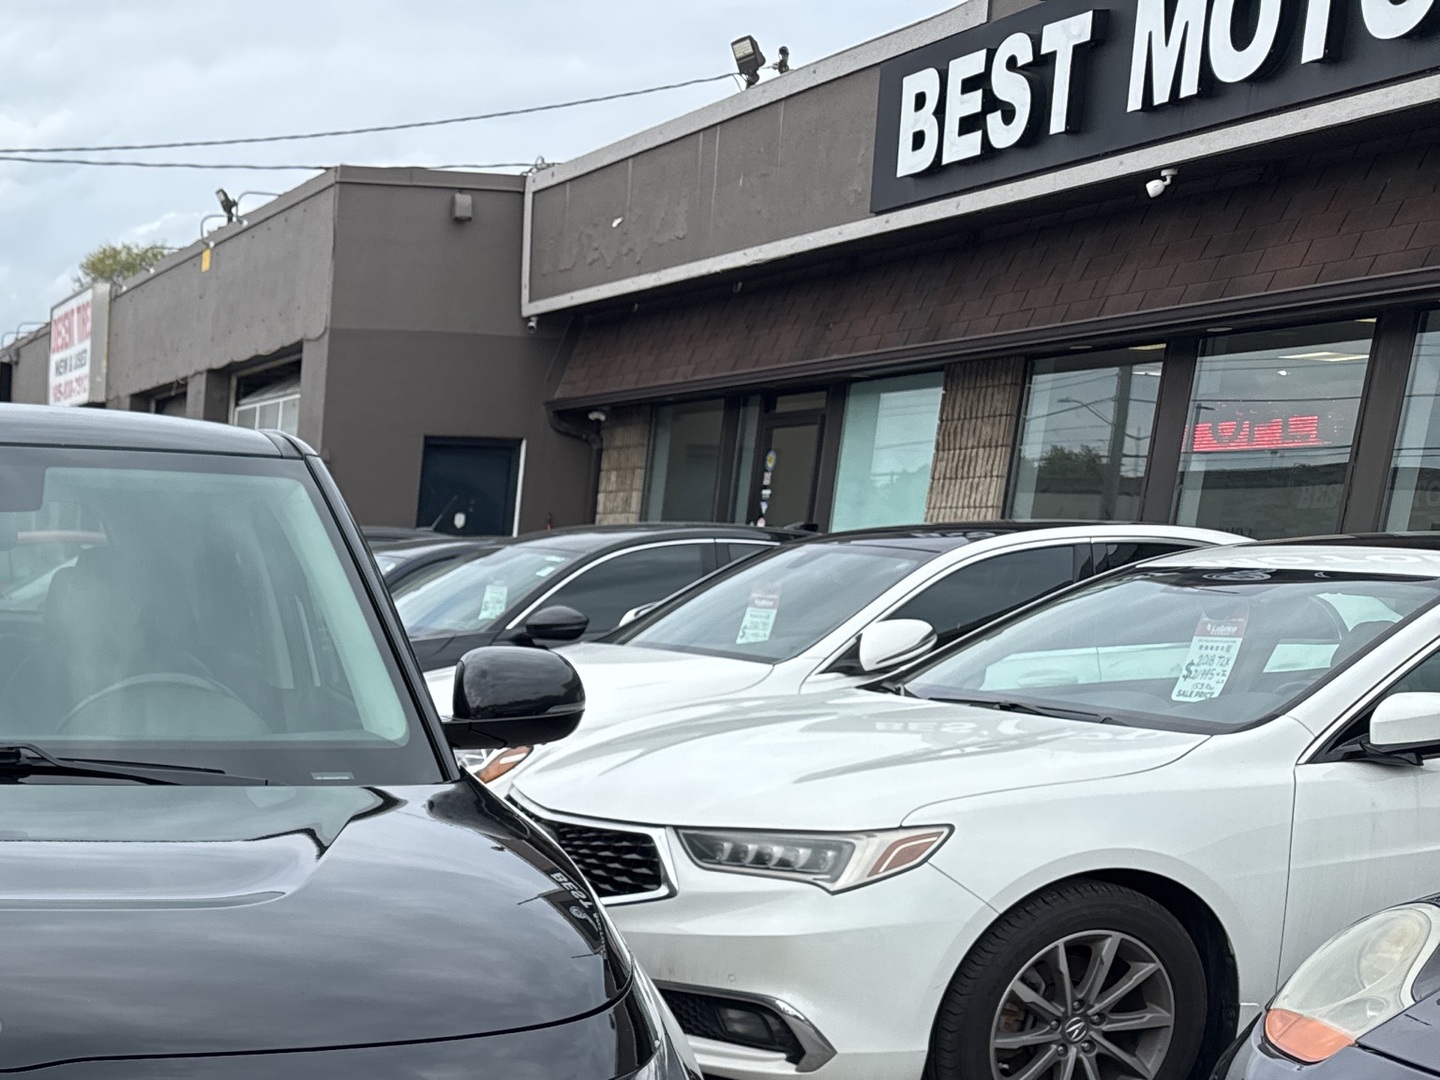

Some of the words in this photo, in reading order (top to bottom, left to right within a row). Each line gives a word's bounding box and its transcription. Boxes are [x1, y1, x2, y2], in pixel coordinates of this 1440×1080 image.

[896, 10, 1094, 177] BEST
[1127, 0, 1440, 112] MO
[1176, 689, 1195, 698] SALE
[1194, 690, 1215, 699] PRICE
